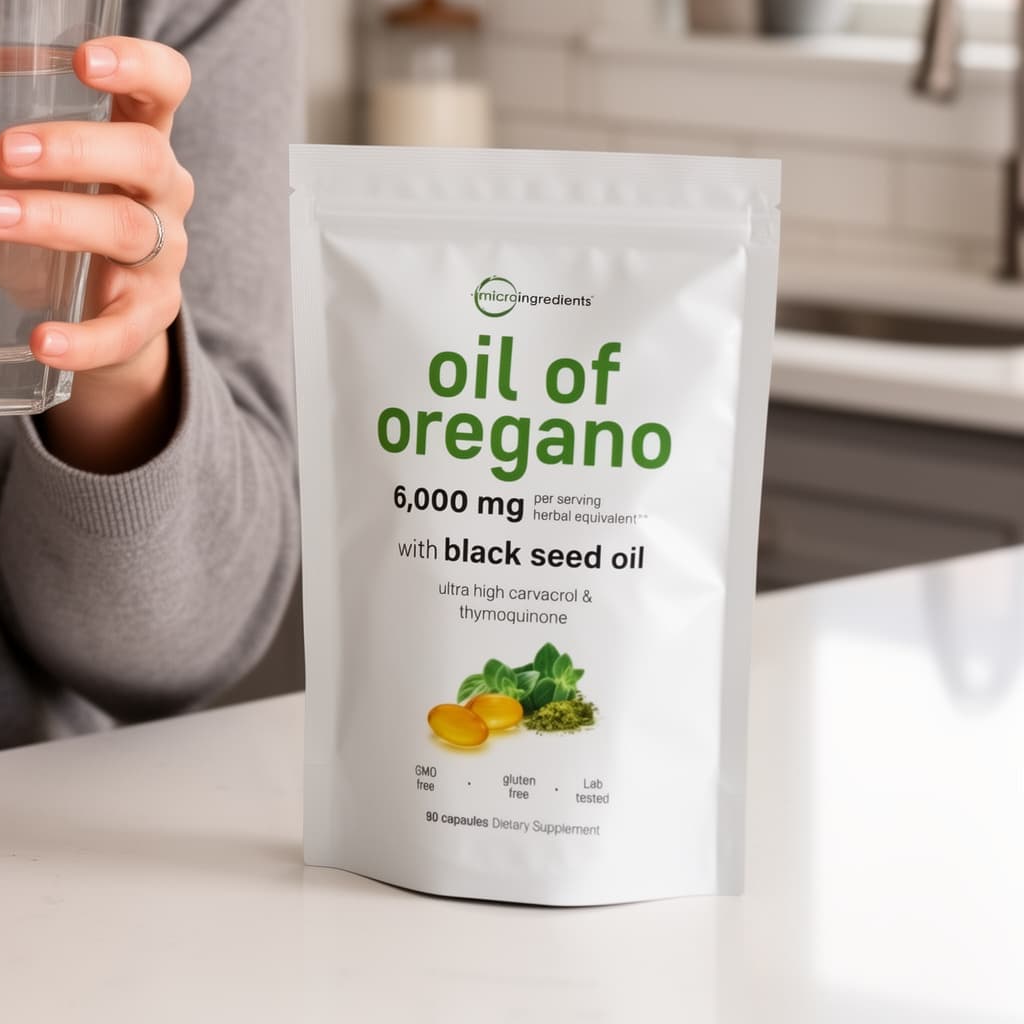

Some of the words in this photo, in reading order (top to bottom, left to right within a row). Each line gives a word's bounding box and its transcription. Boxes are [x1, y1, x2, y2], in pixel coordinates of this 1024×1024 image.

[429, 335, 517, 401] oil
[545, 342, 621, 405] of
[377, 407, 672, 482] oregano
[393, 485, 468, 513] 6,000
[477, 494, 525, 523] mg
[534, 494, 554, 505] per
[557, 494, 601, 509] serving
[533, 509, 571, 522] herbal
[398, 539, 438, 560] with
[444, 538, 521, 566] black
[530, 545, 602, 568] seed
[611, 546, 644, 569] oil
[438, 582, 470, 597] ultra
[473, 584, 504, 601] high
[509, 587, 578, 603] carvacrol
[582, 589, 593, 603] &
[459, 605, 568, 625] thymoquinone
[415, 765, 437, 778] GMO
[416, 779, 435, 792] free
[502, 774, 536, 788] gluten
[583, 778, 603, 790] Lab
[508, 787, 529, 800] free
[576, 792, 609, 804] tested
[492, 817, 530, 833] Dietary
[532, 820, 601, 836] Supplement
